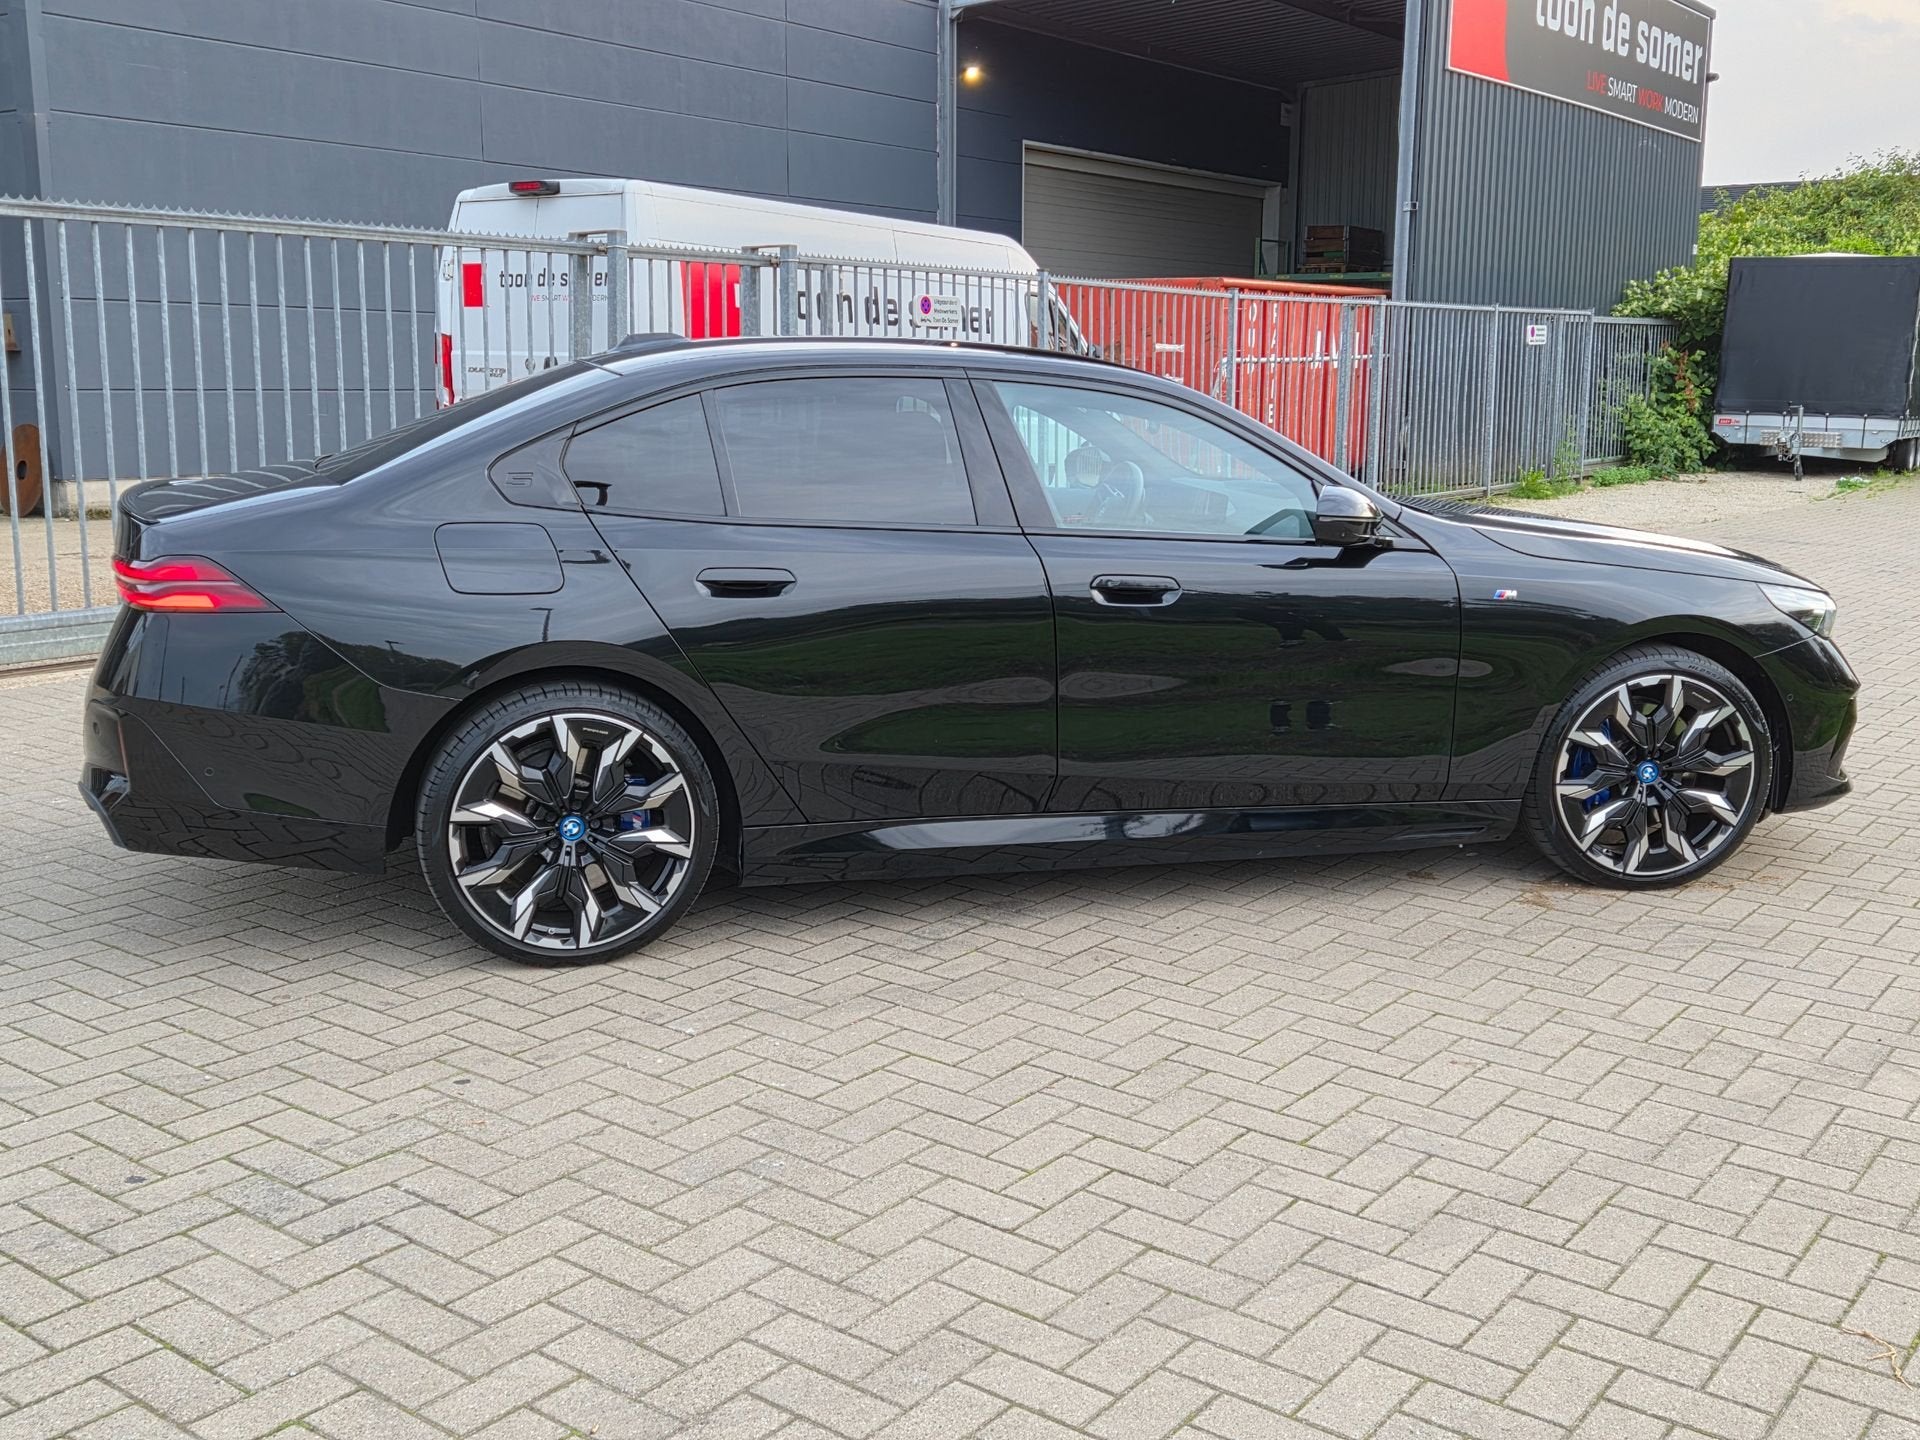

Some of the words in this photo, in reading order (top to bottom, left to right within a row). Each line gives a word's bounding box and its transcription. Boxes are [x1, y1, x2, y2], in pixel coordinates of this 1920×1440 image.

[1536, 0, 1595, 44] toon
[1602, 0, 1630, 57] de
[1636, 20, 1702, 84] somer
[1586, 70, 1606, 95] LIVE
[1607, 77, 1637, 103] SMART
[1638, 88, 1664, 112] WORK
[1664, 96, 1699, 124] MODERN
[864, 286, 899, 326] de
